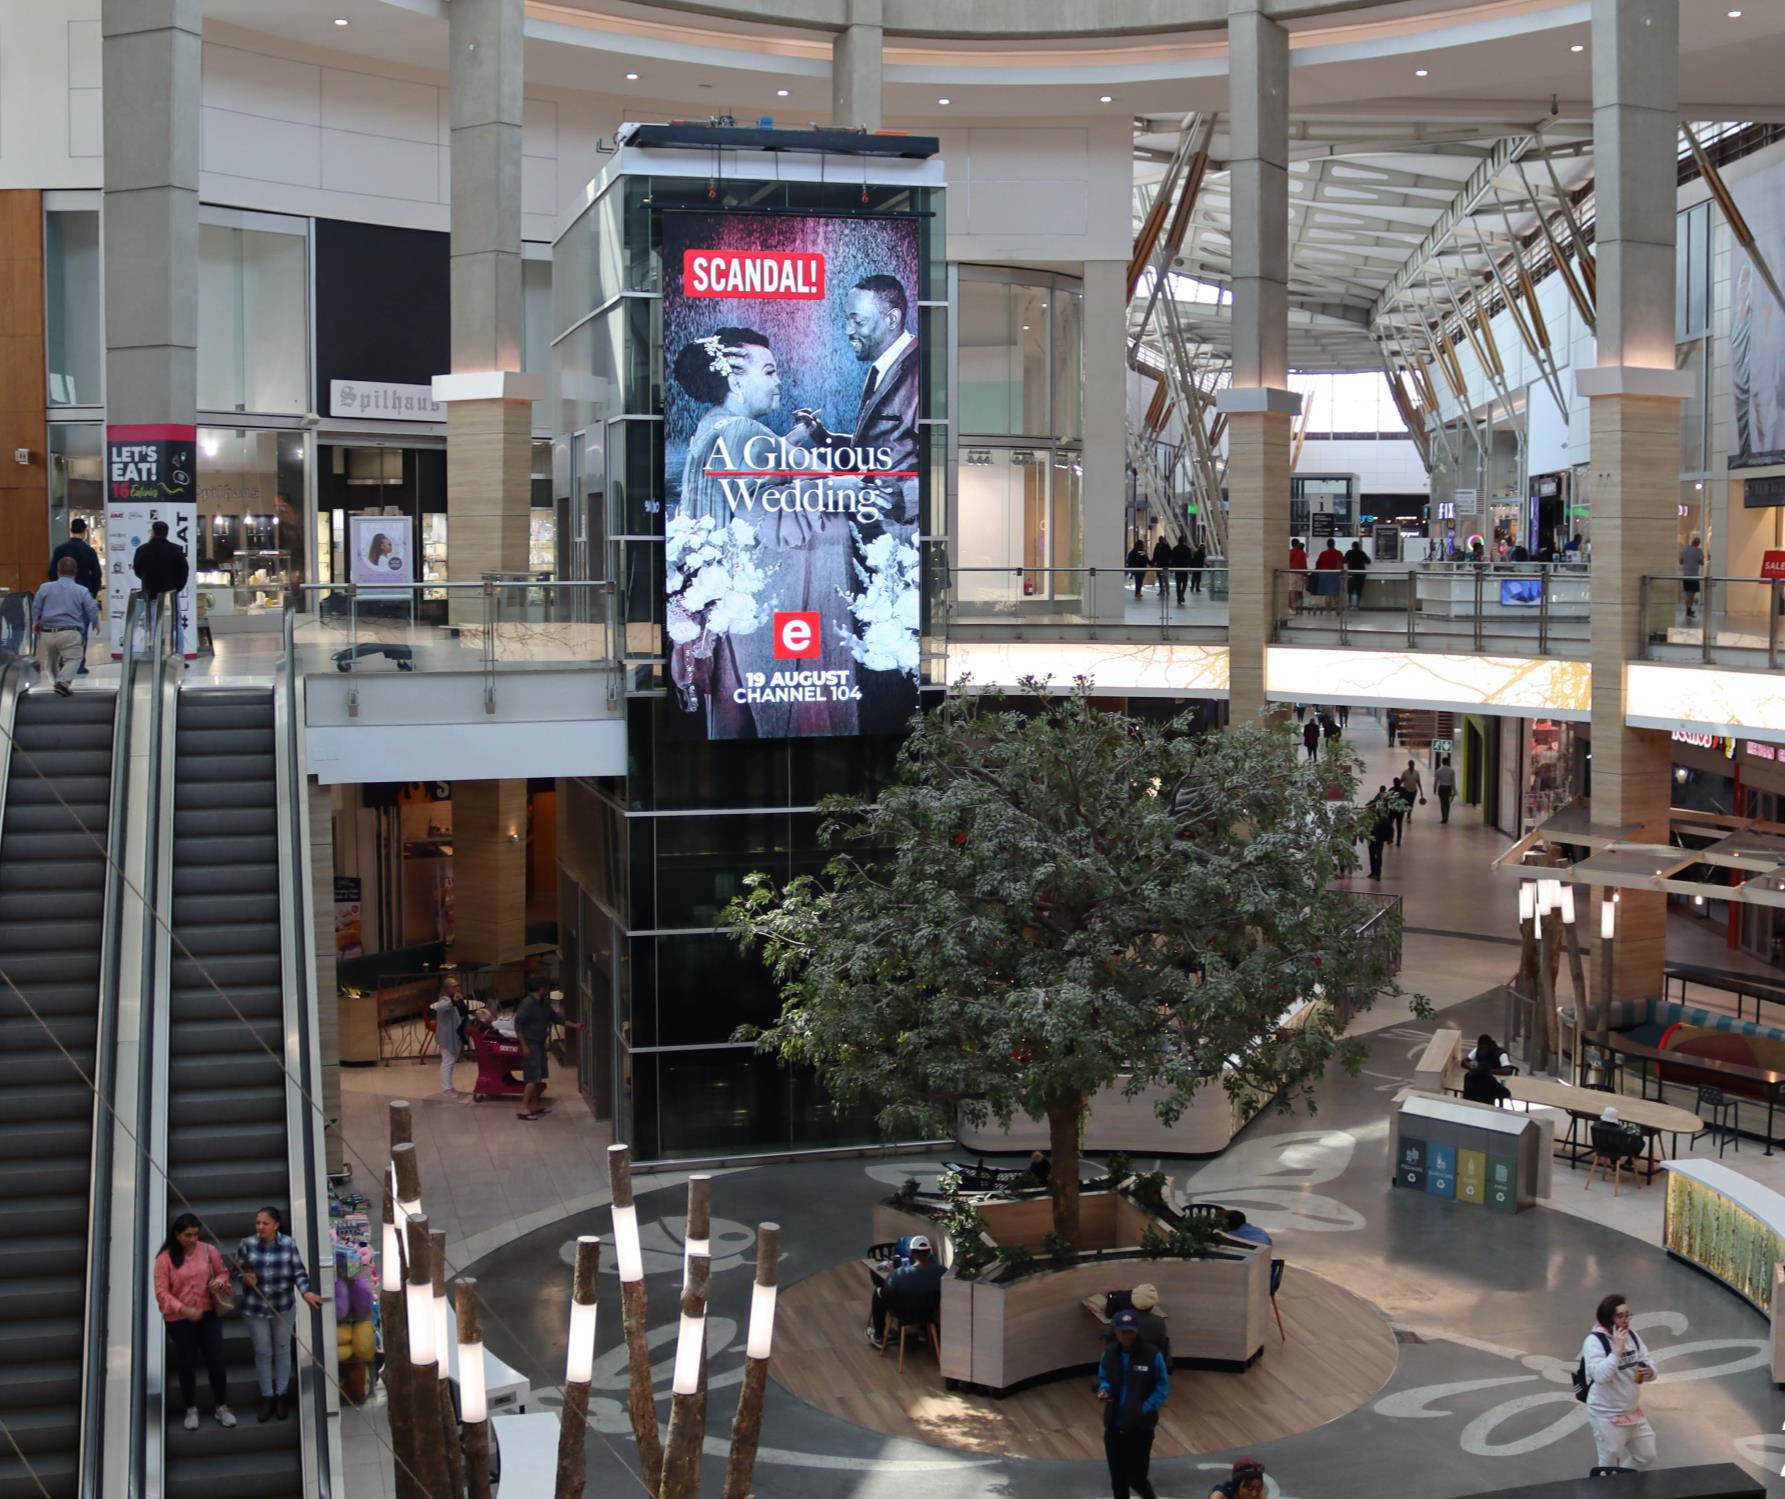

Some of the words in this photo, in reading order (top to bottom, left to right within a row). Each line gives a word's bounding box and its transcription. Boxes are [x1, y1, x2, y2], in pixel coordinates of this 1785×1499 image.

[693, 257, 817, 293] SCANDAL!
[111, 445, 158, 462] LET'S
[703, 436, 736, 470] A
[743, 432, 893, 470] Glorious
[111, 462, 158, 481] EAT!
[718, 478, 881, 524] Wedding
[782, 619, 811, 651] e
[745, 672, 766, 687] 19
[770, 670, 850, 687] AUGUST
[733, 687, 827, 704] CHANNEL
[830, 686, 863, 701] 104
